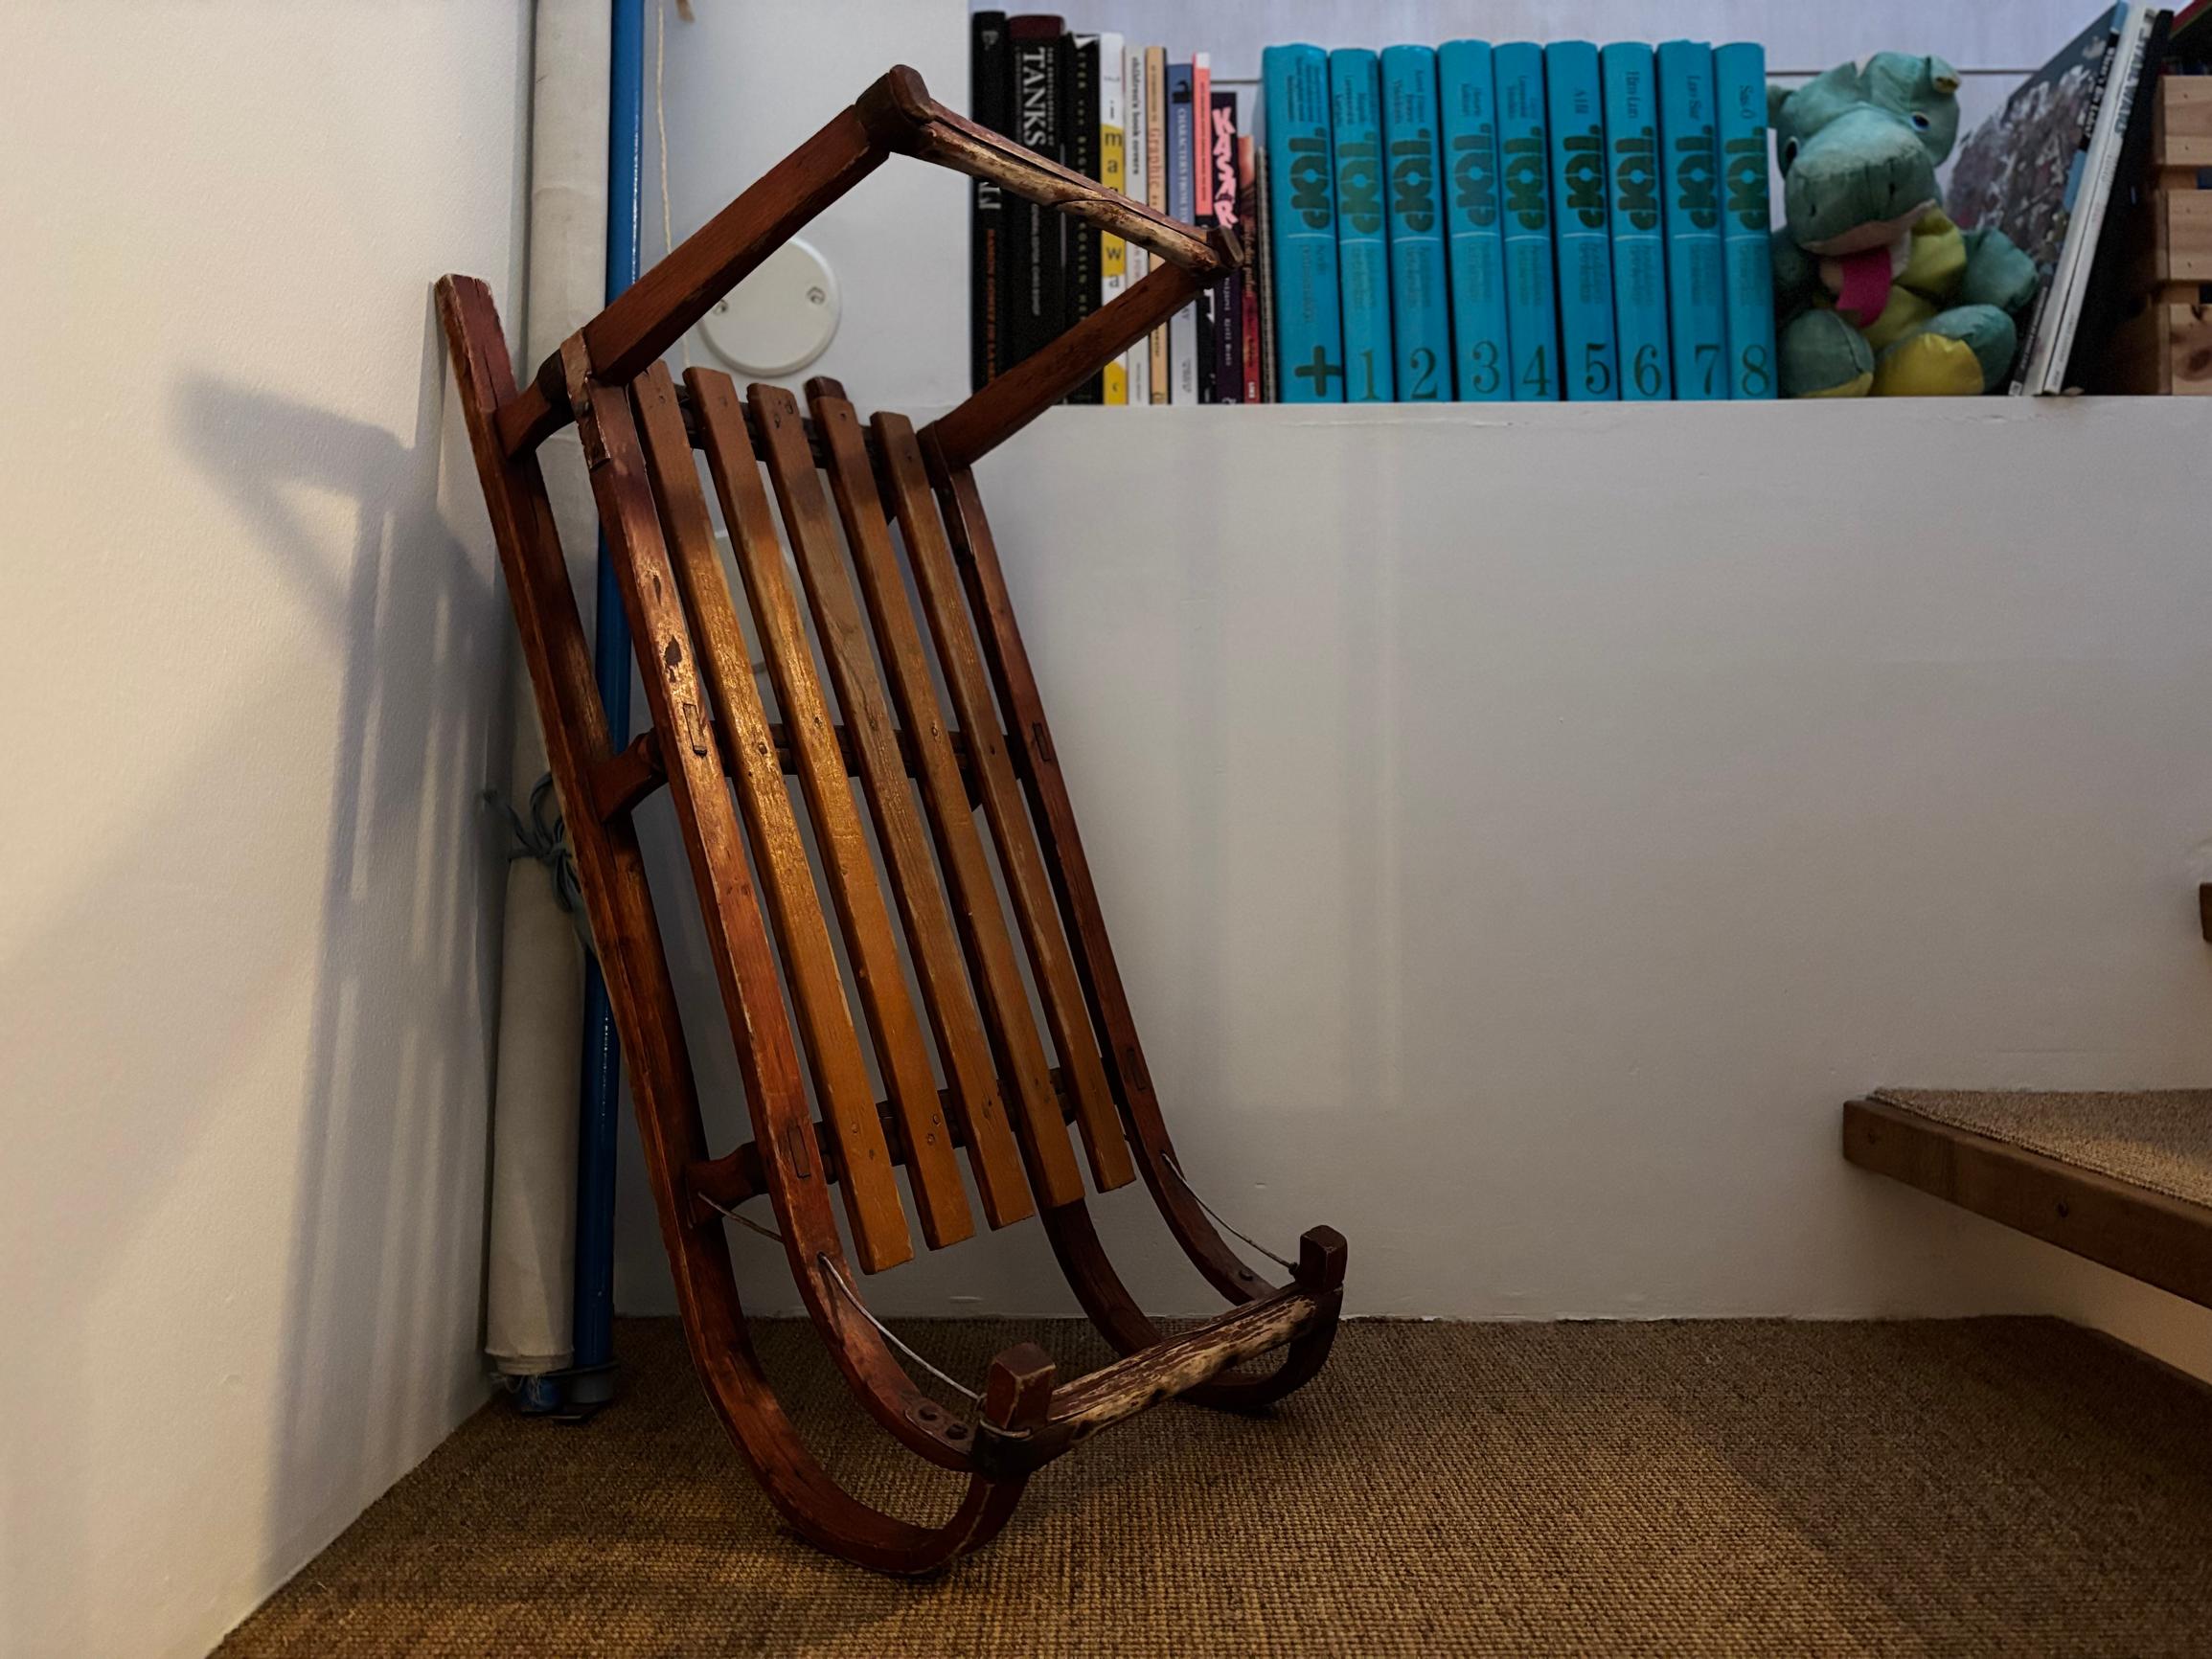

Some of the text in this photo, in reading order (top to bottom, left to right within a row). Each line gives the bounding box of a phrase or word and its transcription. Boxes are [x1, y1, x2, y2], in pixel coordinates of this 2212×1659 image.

[1023, 46, 1046, 146] TANKS
[1359, 348, 1380, 400] 1
[1409, 348, 1438, 400] 2
[1471, 340, 1500, 395] 3
[1522, 344, 1548, 398] 4
[1584, 342, 1611, 395] 5
[1634, 343, 1662, 397] 6
[1694, 344, 1722, 396] 7
[1741, 344, 1769, 397] 8
